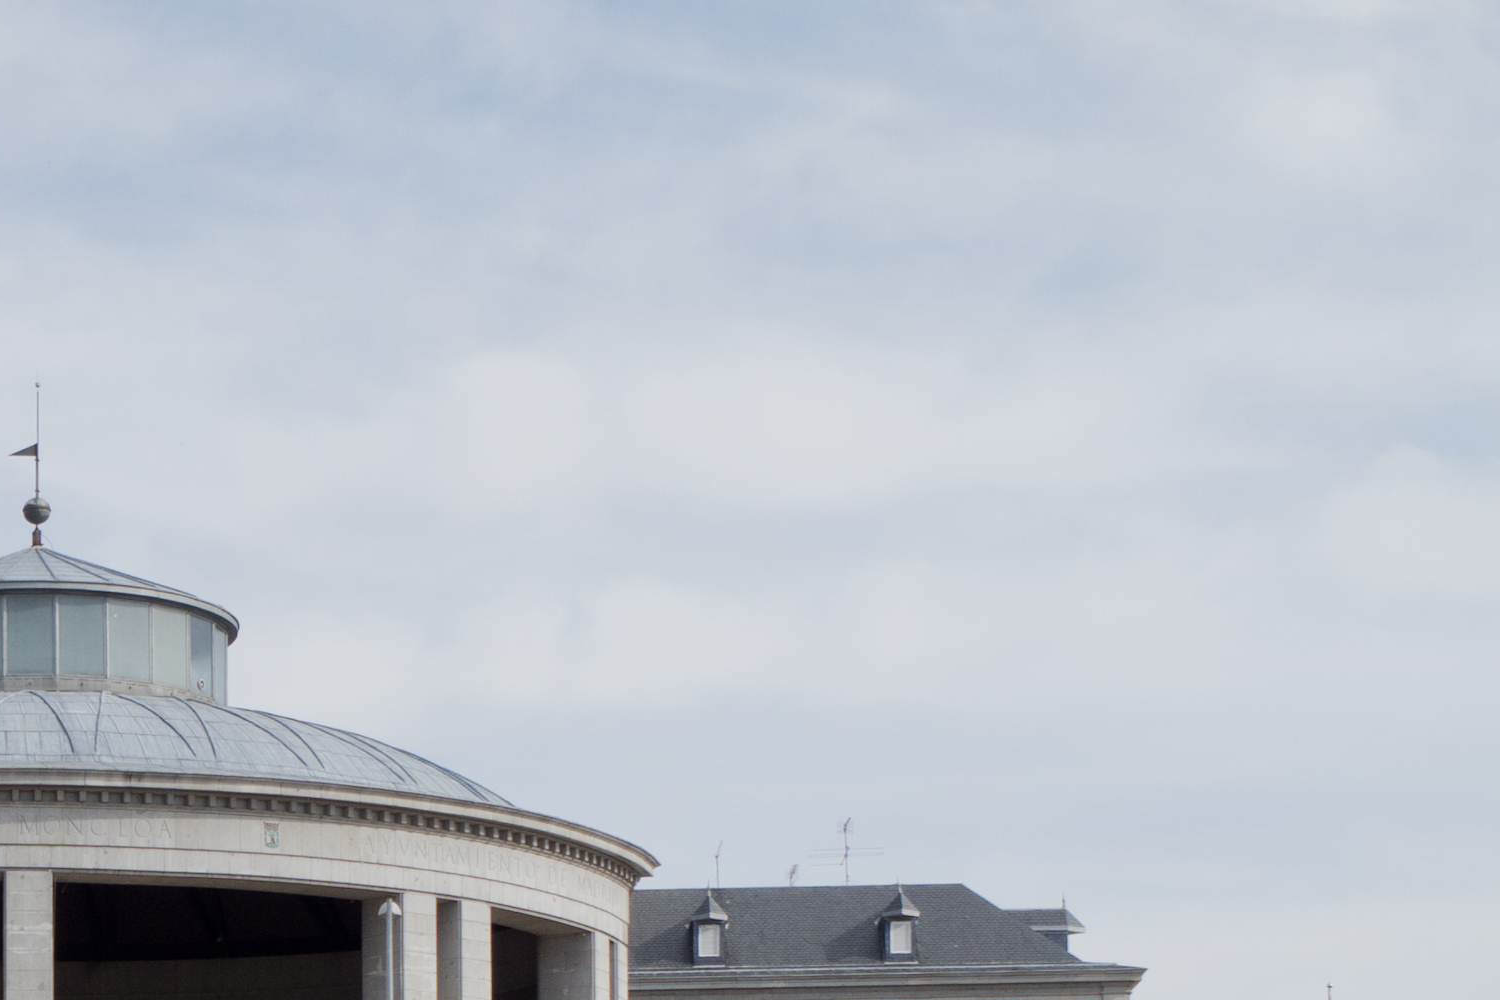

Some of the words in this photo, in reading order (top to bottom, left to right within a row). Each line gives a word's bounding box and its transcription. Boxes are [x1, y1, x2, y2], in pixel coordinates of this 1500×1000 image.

[19, 814, 174, 839] MONCLOA
[364, 833, 536, 880] AYVNTAMIENTO
[547, 864, 567, 888] DE
